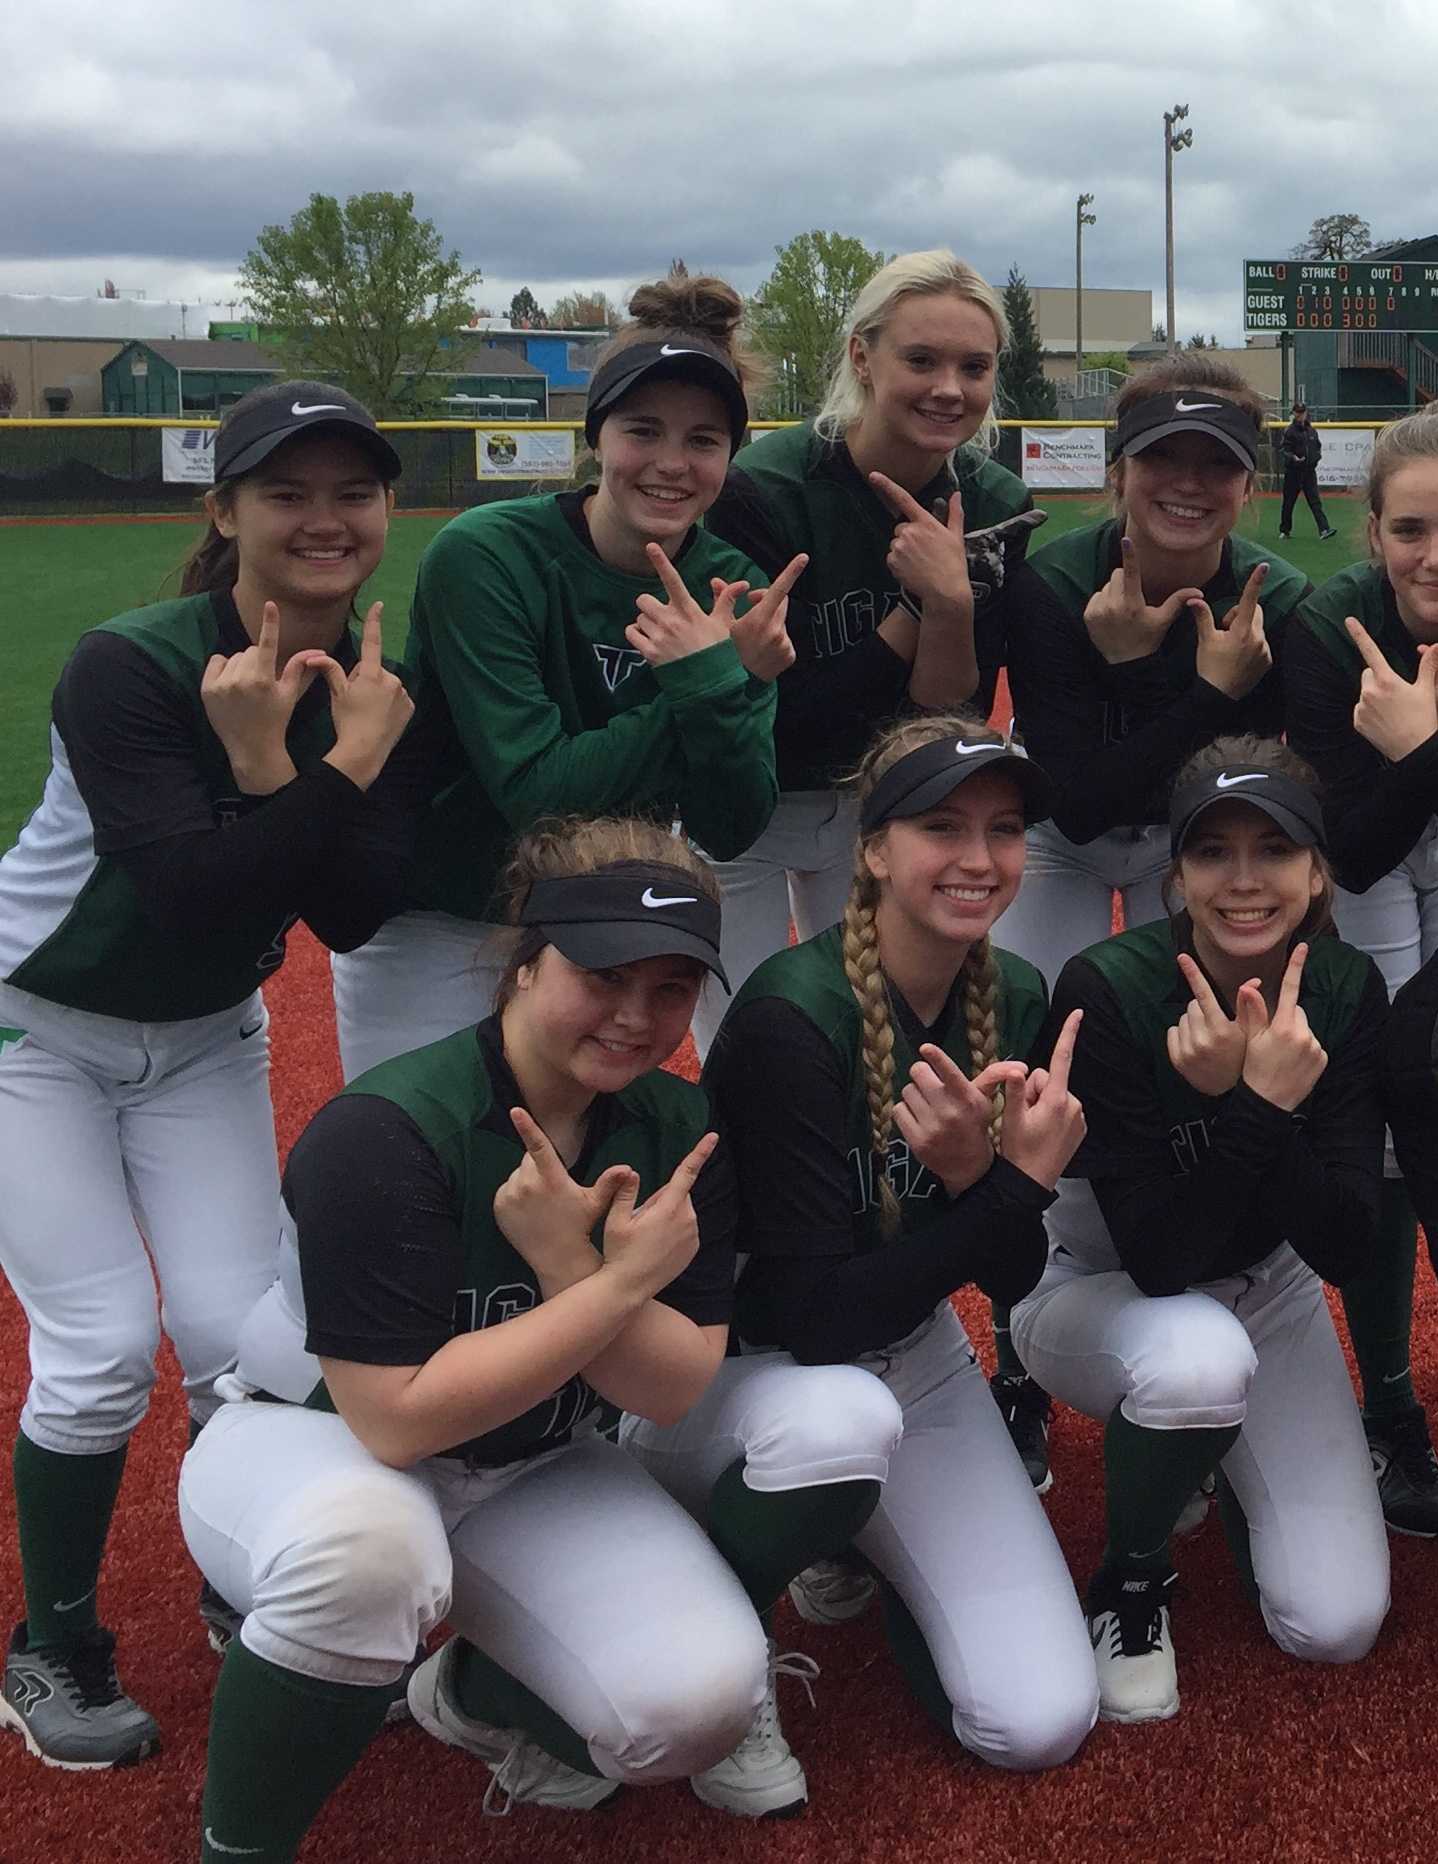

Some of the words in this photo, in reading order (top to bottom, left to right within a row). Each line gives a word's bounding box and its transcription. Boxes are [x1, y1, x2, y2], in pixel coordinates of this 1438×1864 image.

[1249, 266, 1274, 277] BALL
[1277, 264, 1286, 280] 0
[1302, 267, 1336, 278] STRIKE
[1339, 265, 1348, 281] 0
[1371, 268, 1391, 279] OUT
[1393, 265, 1402, 281] 0
[1299, 286, 1303, 294] 1
[1311, 286, 1317, 295] 2
[1325, 286, 1330, 295] 3
[1343, 286, 1348, 295] 4
[1356, 287, 1362, 296] 5
[1388, 287, 1394, 296] 7
[1401, 287, 1407, 296] 8
[1414, 287, 1420, 296] 9
[1248, 295, 1284, 308] GUEST
[1323, 296, 1332, 310] 0
[1342, 297, 1350, 310] 0
[1355, 297, 1364, 310] 0
[1368, 297, 1377, 310] 0
[1387, 297, 1395, 310] 0
[1247, 313, 1287, 326] TIGERS
[1297, 313, 1305, 327] 0
[1310, 313, 1318, 327] 0
[1323, 313, 1332, 327] 0
[1343, 313, 1350, 328] 3
[1355, 313, 1364, 328] 0
[1368, 313, 1377, 328] 0
[1121, 1580, 1150, 1592] NIKE
